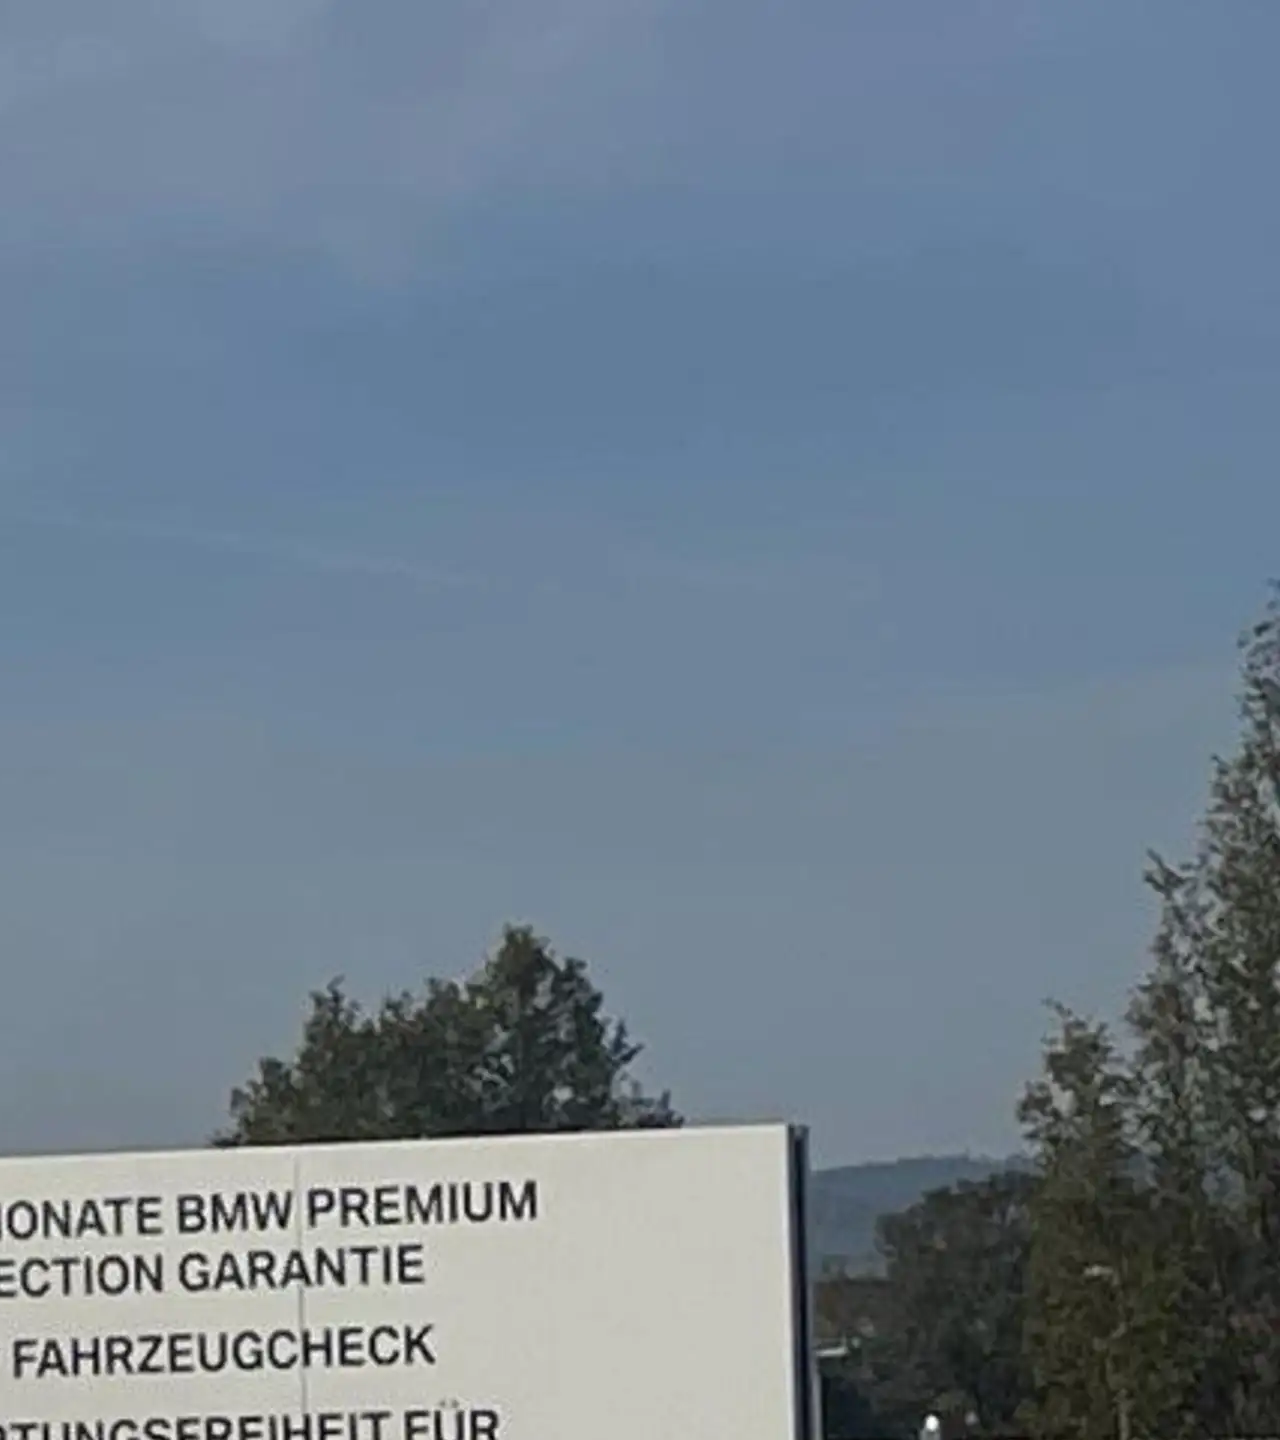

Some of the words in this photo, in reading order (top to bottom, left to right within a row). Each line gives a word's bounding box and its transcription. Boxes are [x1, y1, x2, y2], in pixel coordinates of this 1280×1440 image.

[178, 1190, 292, 1235] BMW
[307, 1179, 538, 1229] PREMIUM
[178, 1243, 426, 1292] GARANTIE
[12, 1323, 437, 1379] FAHRZEUGCHECK
